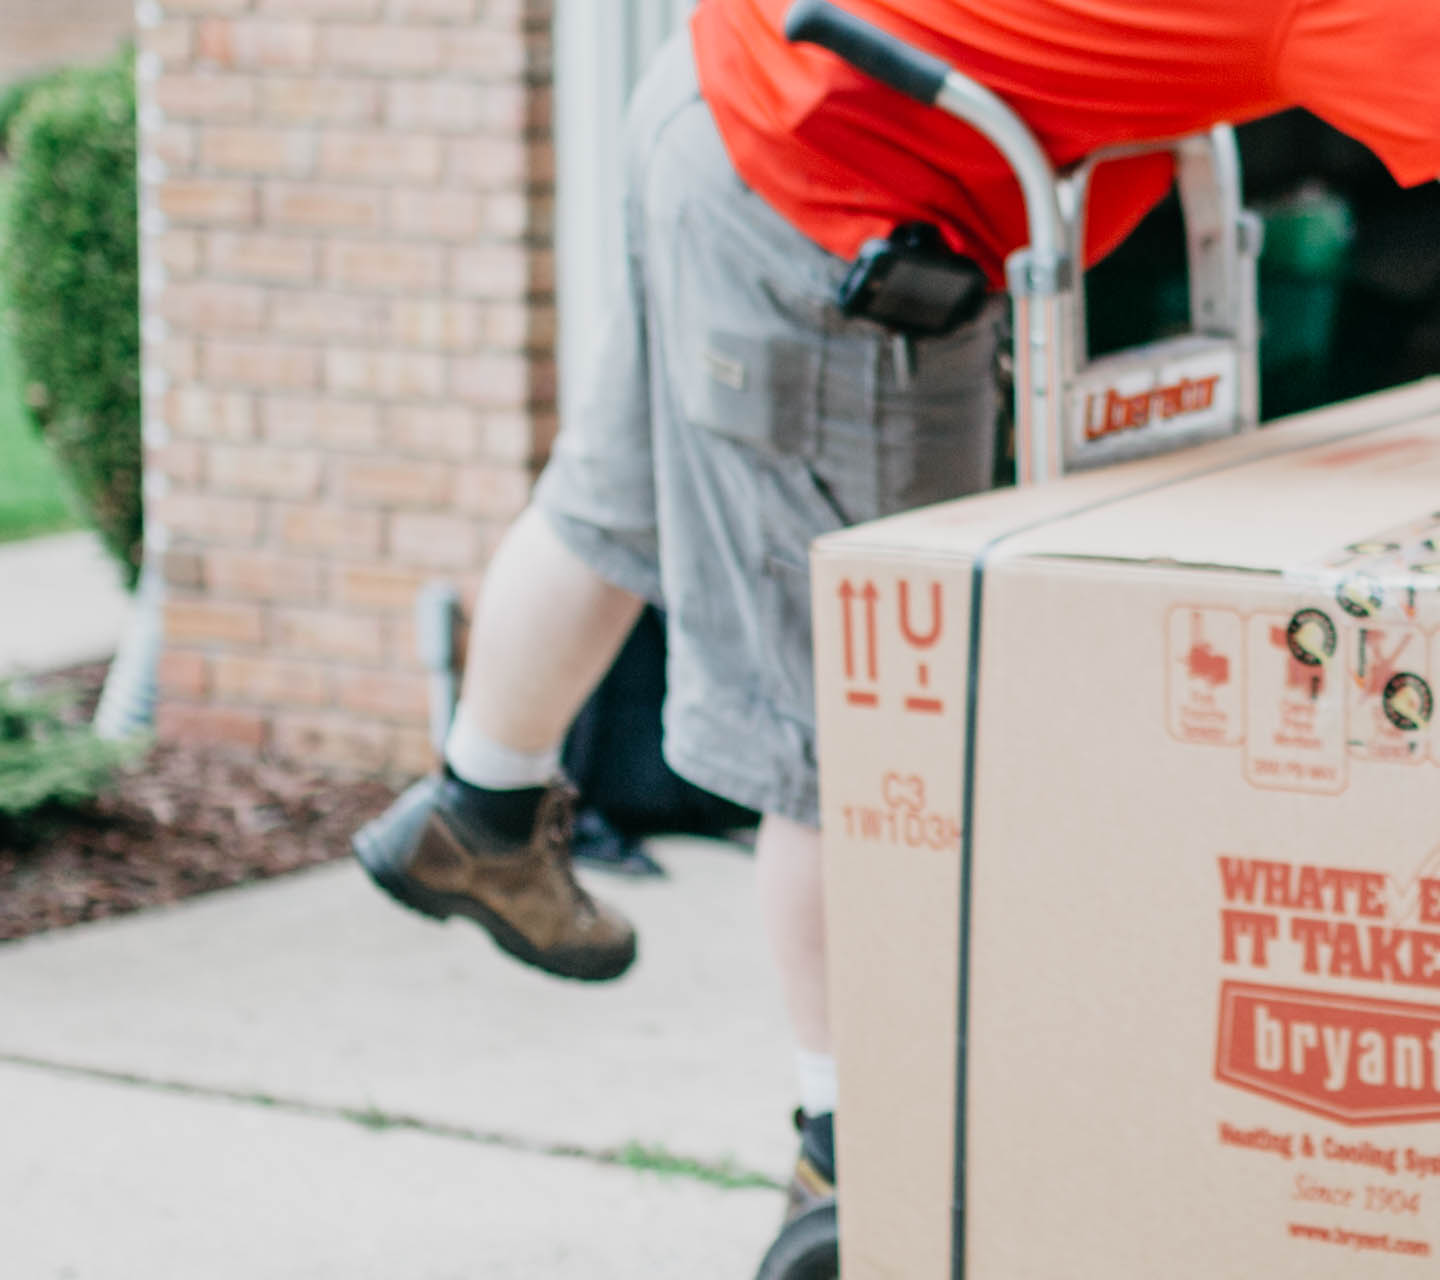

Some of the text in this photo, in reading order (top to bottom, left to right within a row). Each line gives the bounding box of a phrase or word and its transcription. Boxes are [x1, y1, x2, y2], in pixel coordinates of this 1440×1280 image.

[1219, 907, 1278, 968] IT
[1218, 1122, 1292, 1160] Heating
[1324, 1137, 1397, 1174] Cooling
[1293, 1174, 1421, 1215] Since 1904
[1288, 1223, 1430, 1257] www.bryant.com
